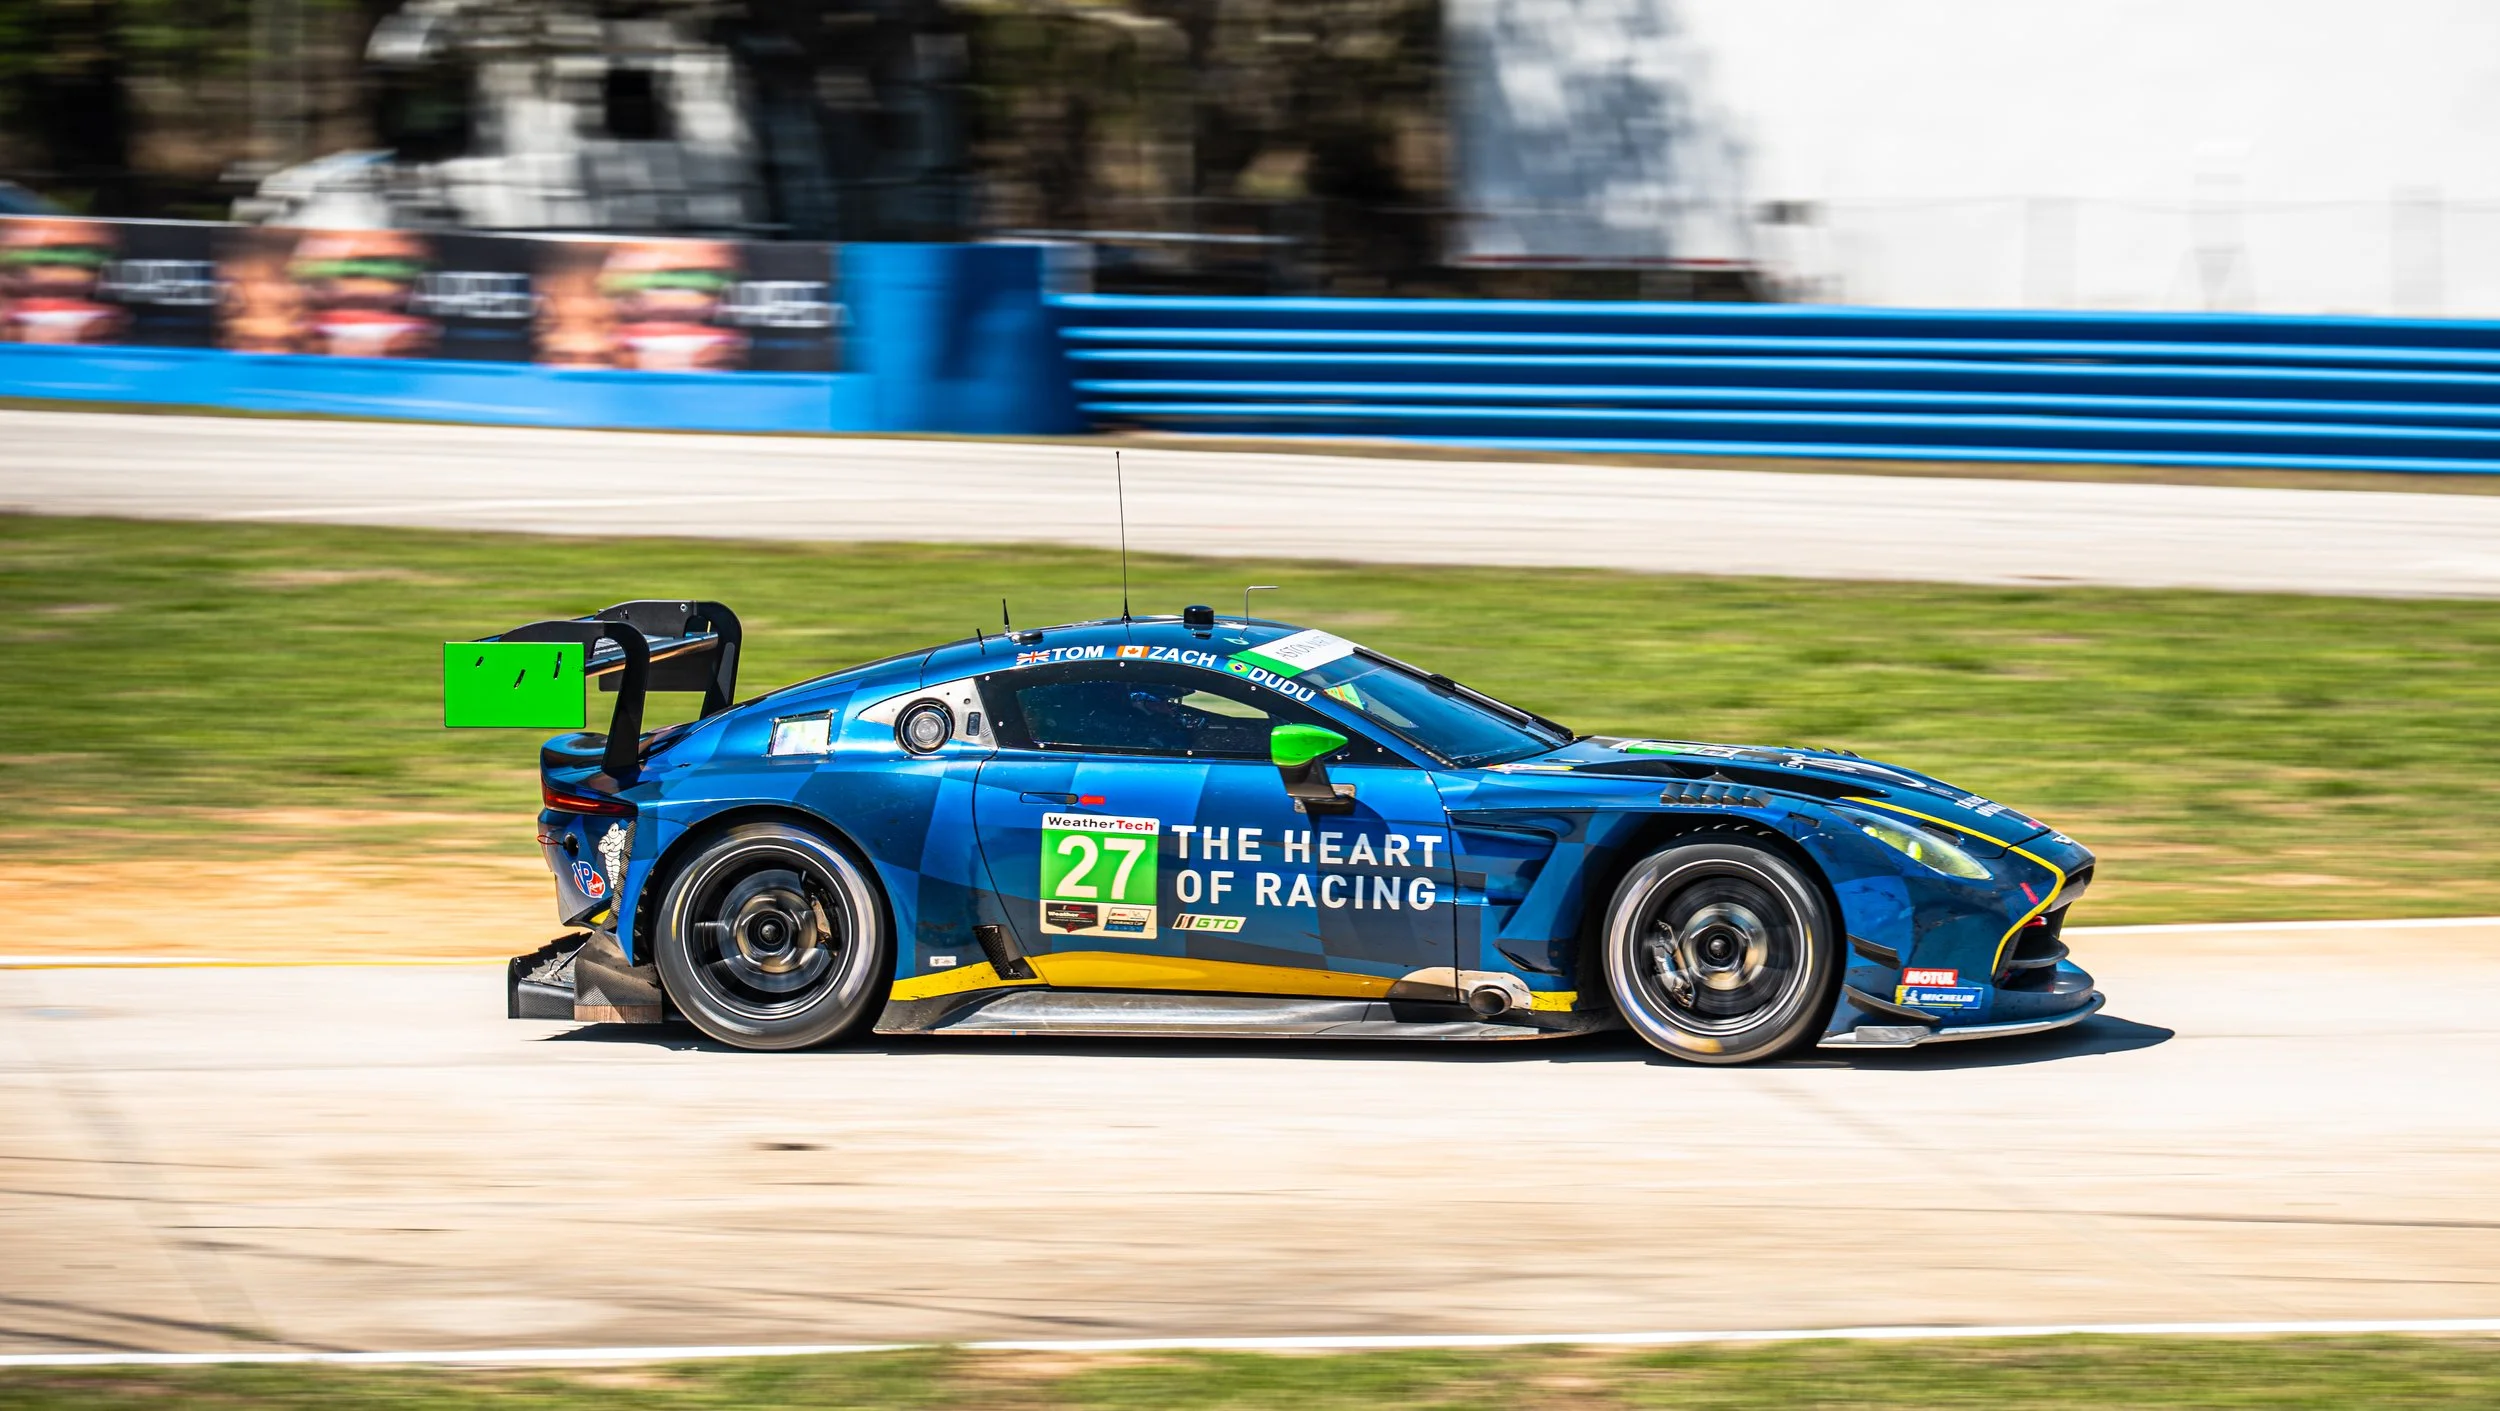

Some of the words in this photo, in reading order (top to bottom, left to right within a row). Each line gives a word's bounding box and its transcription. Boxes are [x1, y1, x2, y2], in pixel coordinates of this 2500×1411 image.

[1052, 645, 1104, 660] TOM
[1148, 646, 1217, 668] ZACH
[1248, 667, 1316, 702] DUDU
[1048, 816, 1154, 832] WeatherTech
[1171, 825, 1263, 861] THE
[1284, 829, 1443, 868] HEART
[1055, 834, 1146, 900] 27
[572, 861, 593, 896] VP
[1176, 869, 1234, 904] OF
[1255, 871, 1436, 911] RACING
[1196, 917, 1239, 930] GTD
[1905, 971, 1956, 985] MOTUL
[1920, 993, 1976, 1003] MICHELIN
